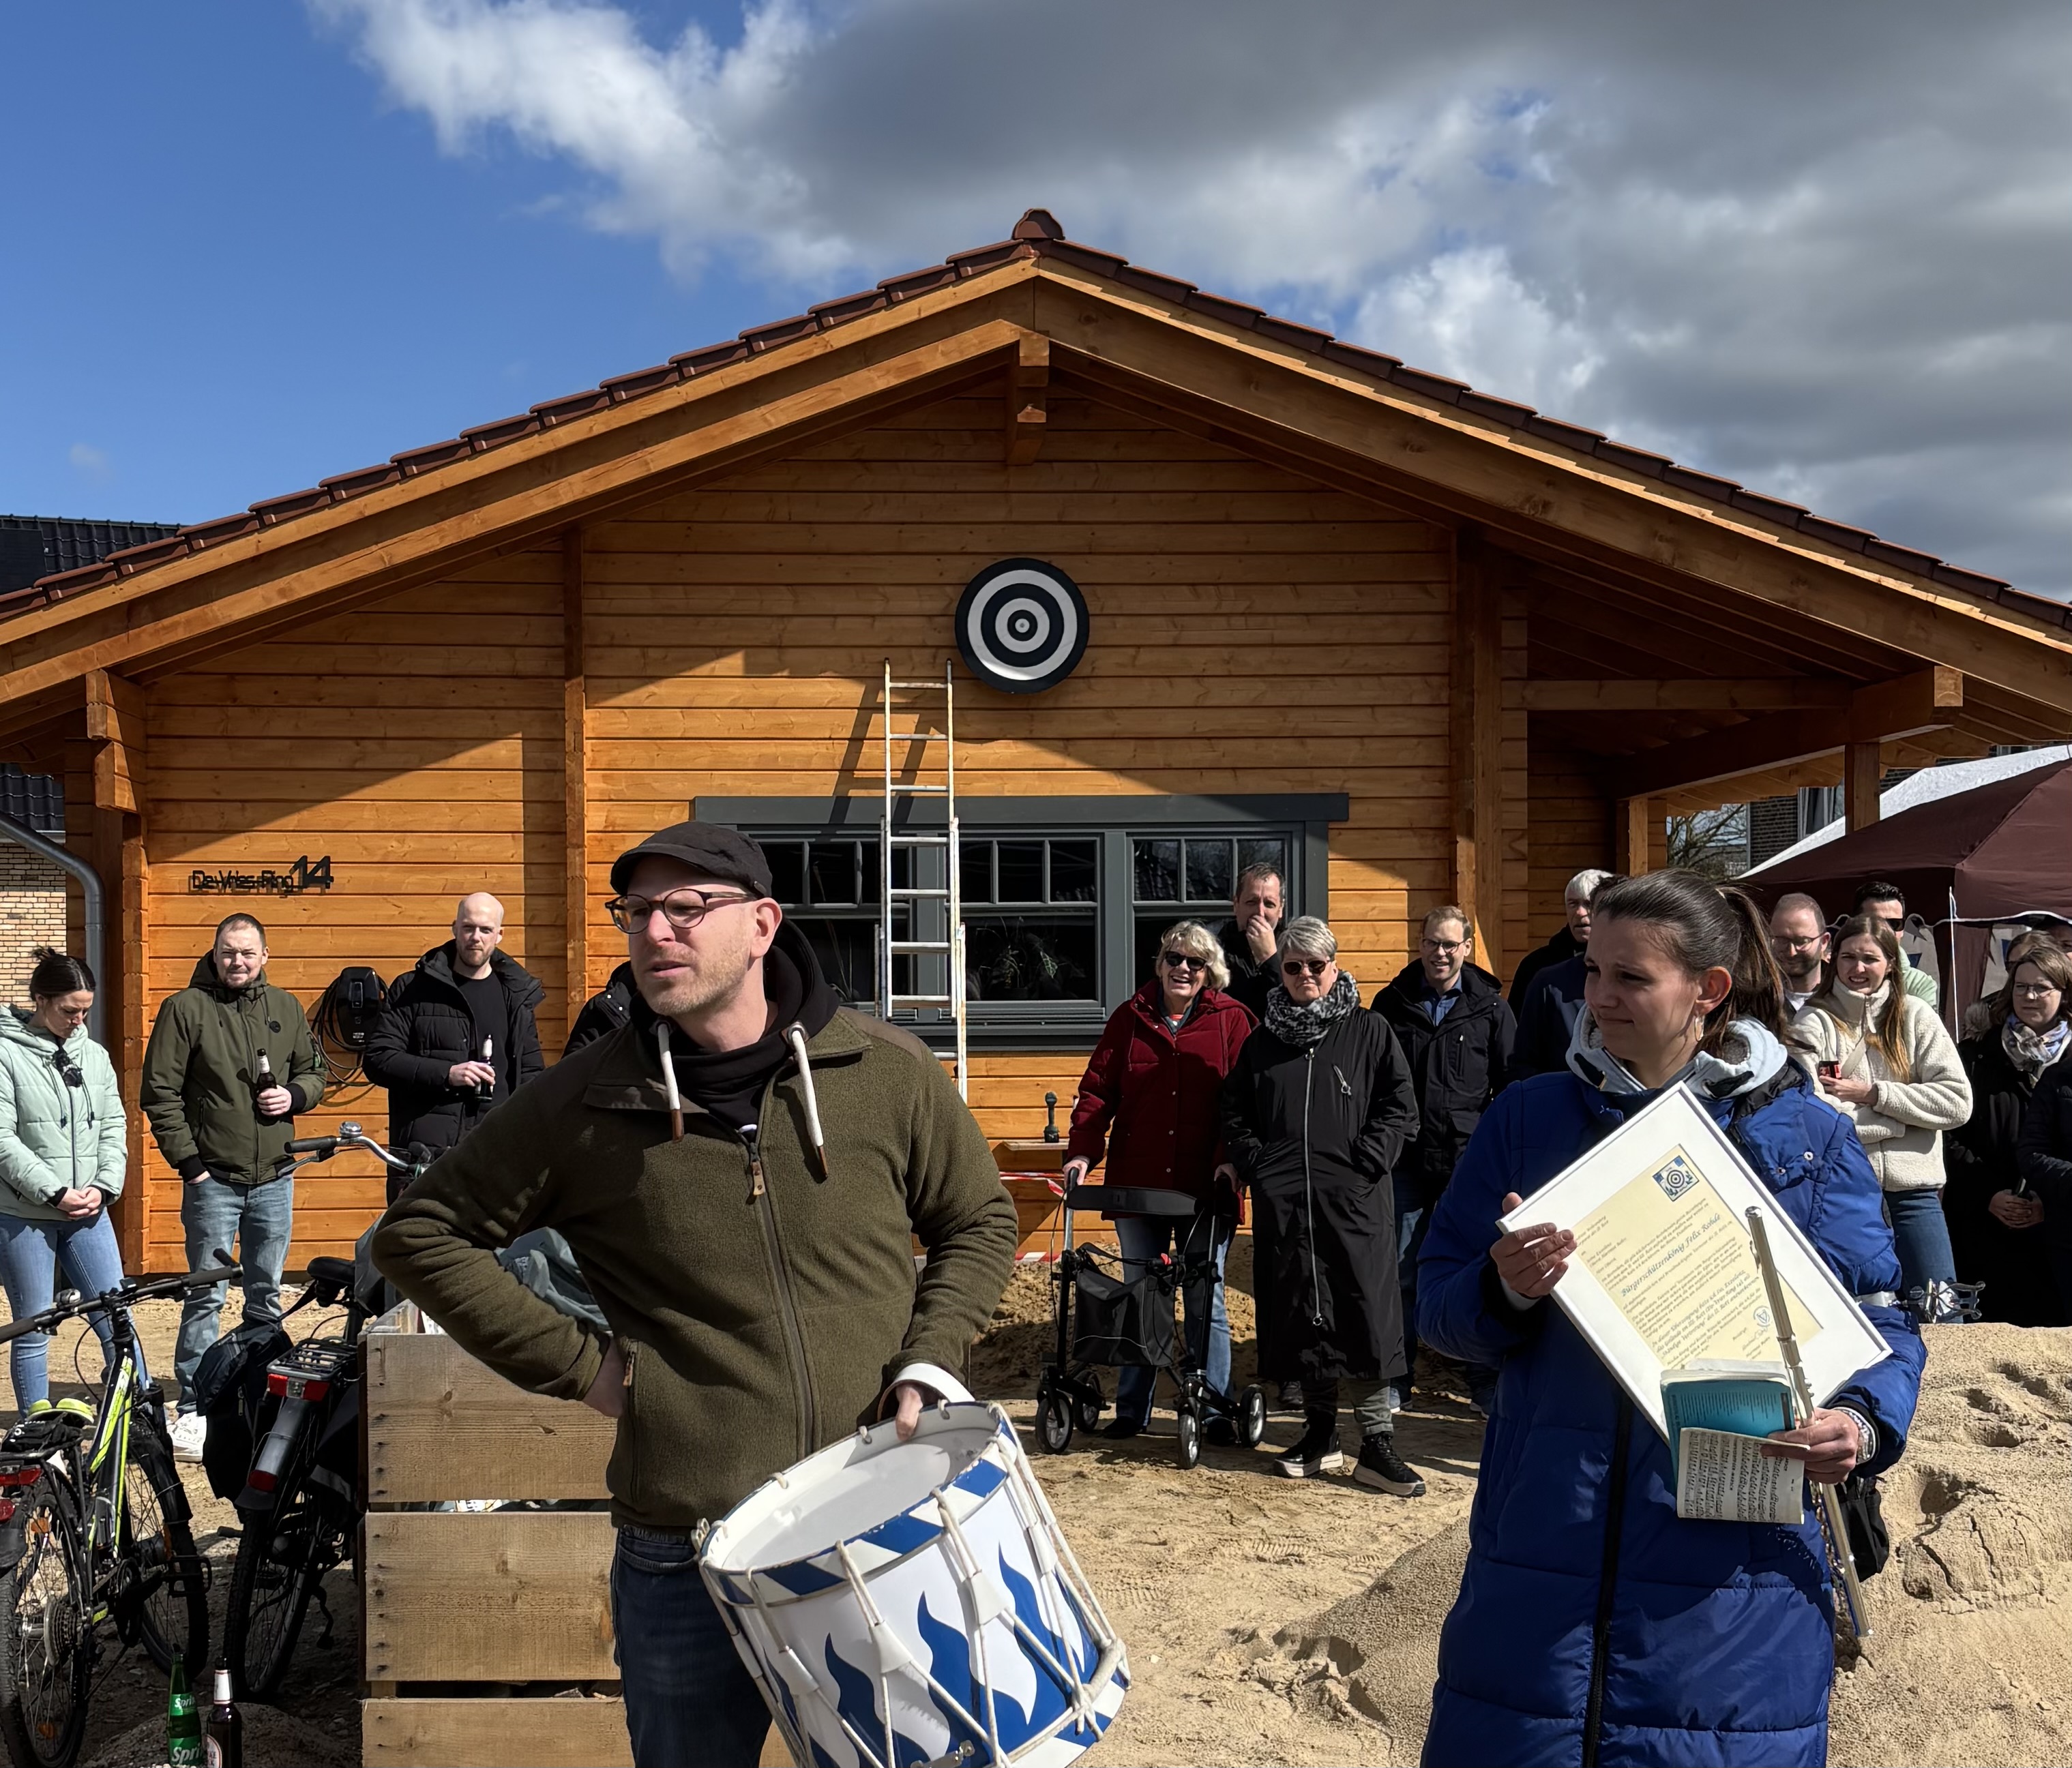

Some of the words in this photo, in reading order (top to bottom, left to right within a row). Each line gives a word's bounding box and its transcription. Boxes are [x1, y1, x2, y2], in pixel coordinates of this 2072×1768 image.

[289, 855, 334, 889] 14
[1621, 1242, 1685, 1295] Bürgerschützenkönig
[1684, 1229, 1700, 1246] Felix
[172, 1742, 201, 1765] Spri
